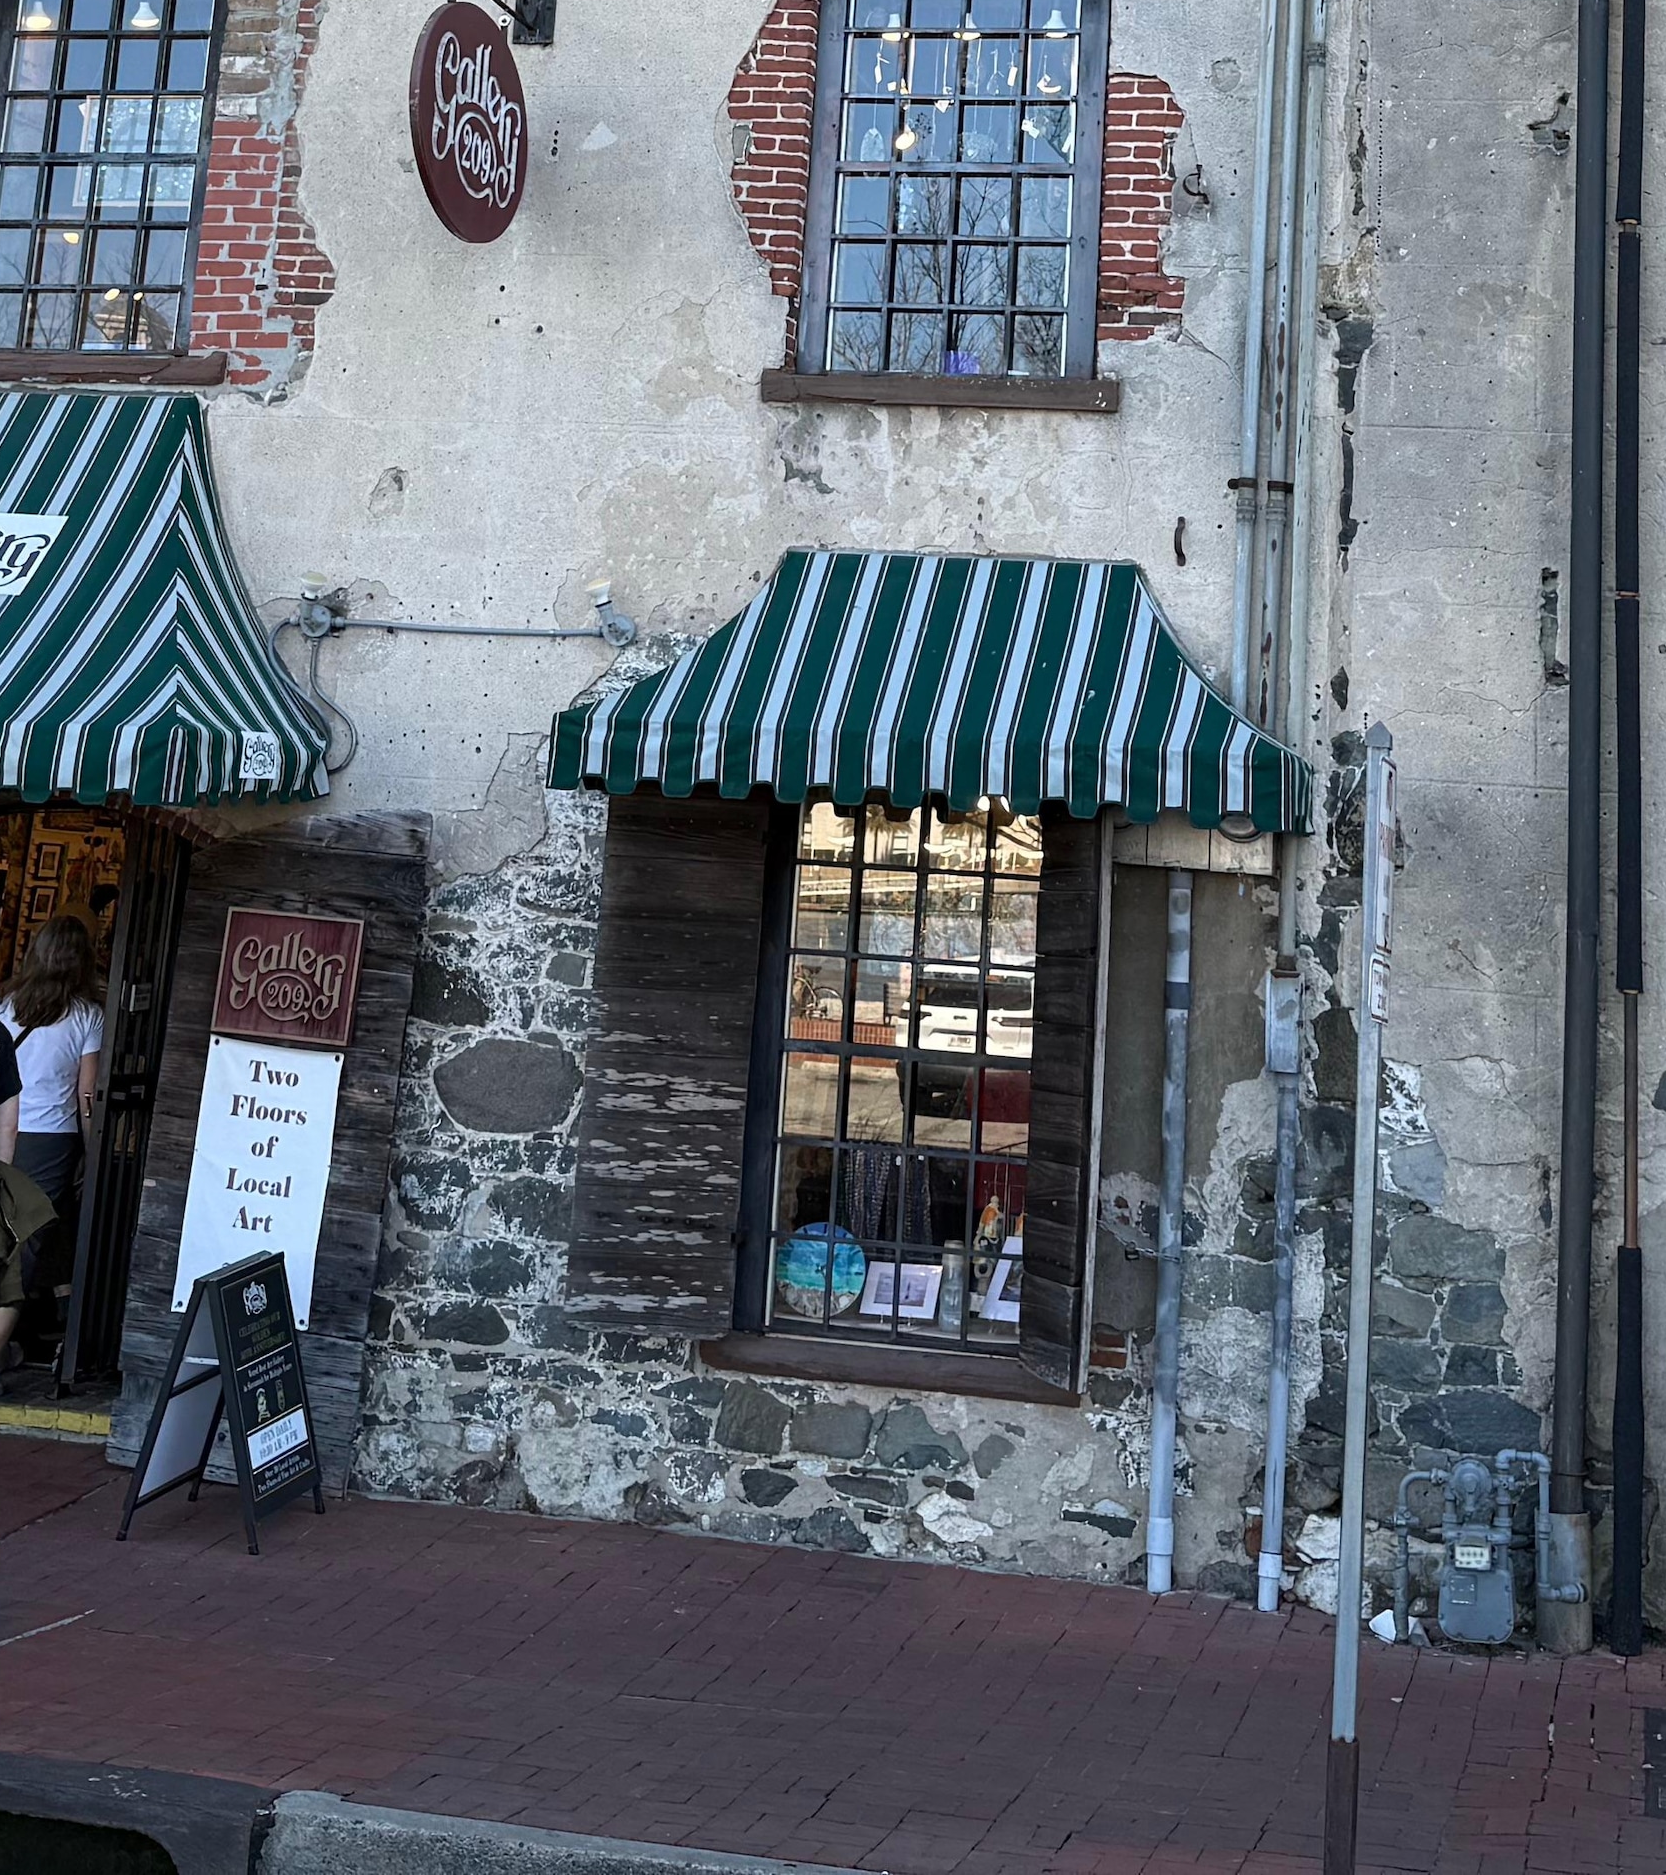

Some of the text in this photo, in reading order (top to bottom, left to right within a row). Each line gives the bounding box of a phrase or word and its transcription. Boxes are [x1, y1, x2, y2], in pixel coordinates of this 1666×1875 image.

[432, 31, 522, 209] Gallery
[460, 123, 495, 184] 209
[229, 929, 347, 1021] Gallery
[267, 980, 307, 1013] 209
[249, 1059, 300, 1088] Two
[230, 1093, 308, 1126] Floors
[251, 1136, 279, 1159] of
[226, 1168, 293, 1198] Local
[232, 1206, 274, 1234] Art
